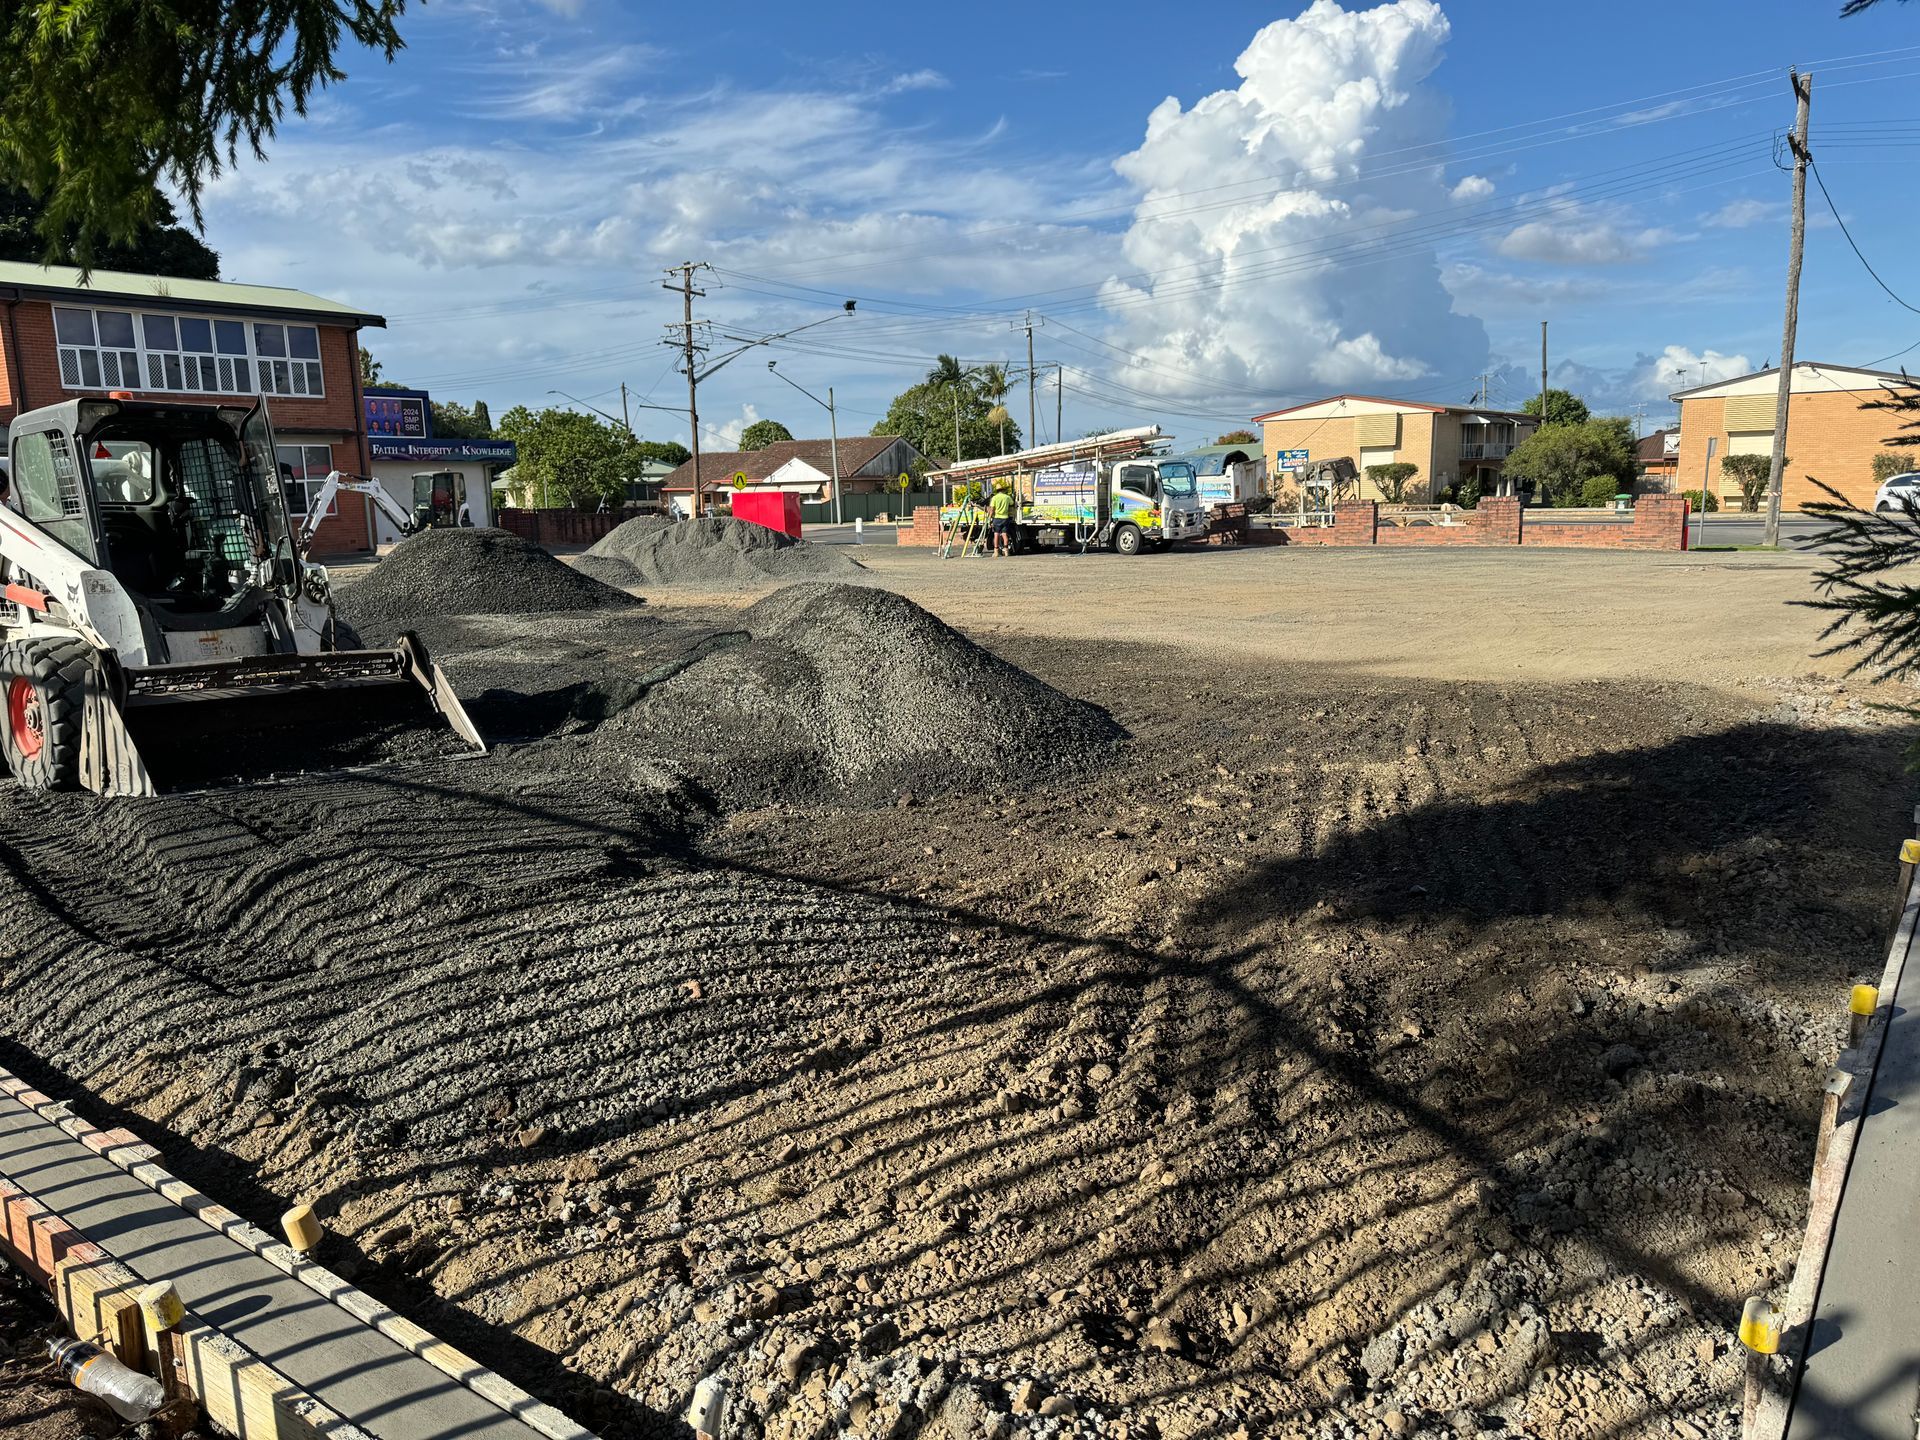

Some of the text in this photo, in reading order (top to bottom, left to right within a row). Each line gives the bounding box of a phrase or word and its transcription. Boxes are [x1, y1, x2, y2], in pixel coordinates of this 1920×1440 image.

[403, 408, 419, 416] 2024
[404, 416, 419, 424] SMP
[372, 444, 512, 456] FAITH INTEGRITY KNOWLEDGE
